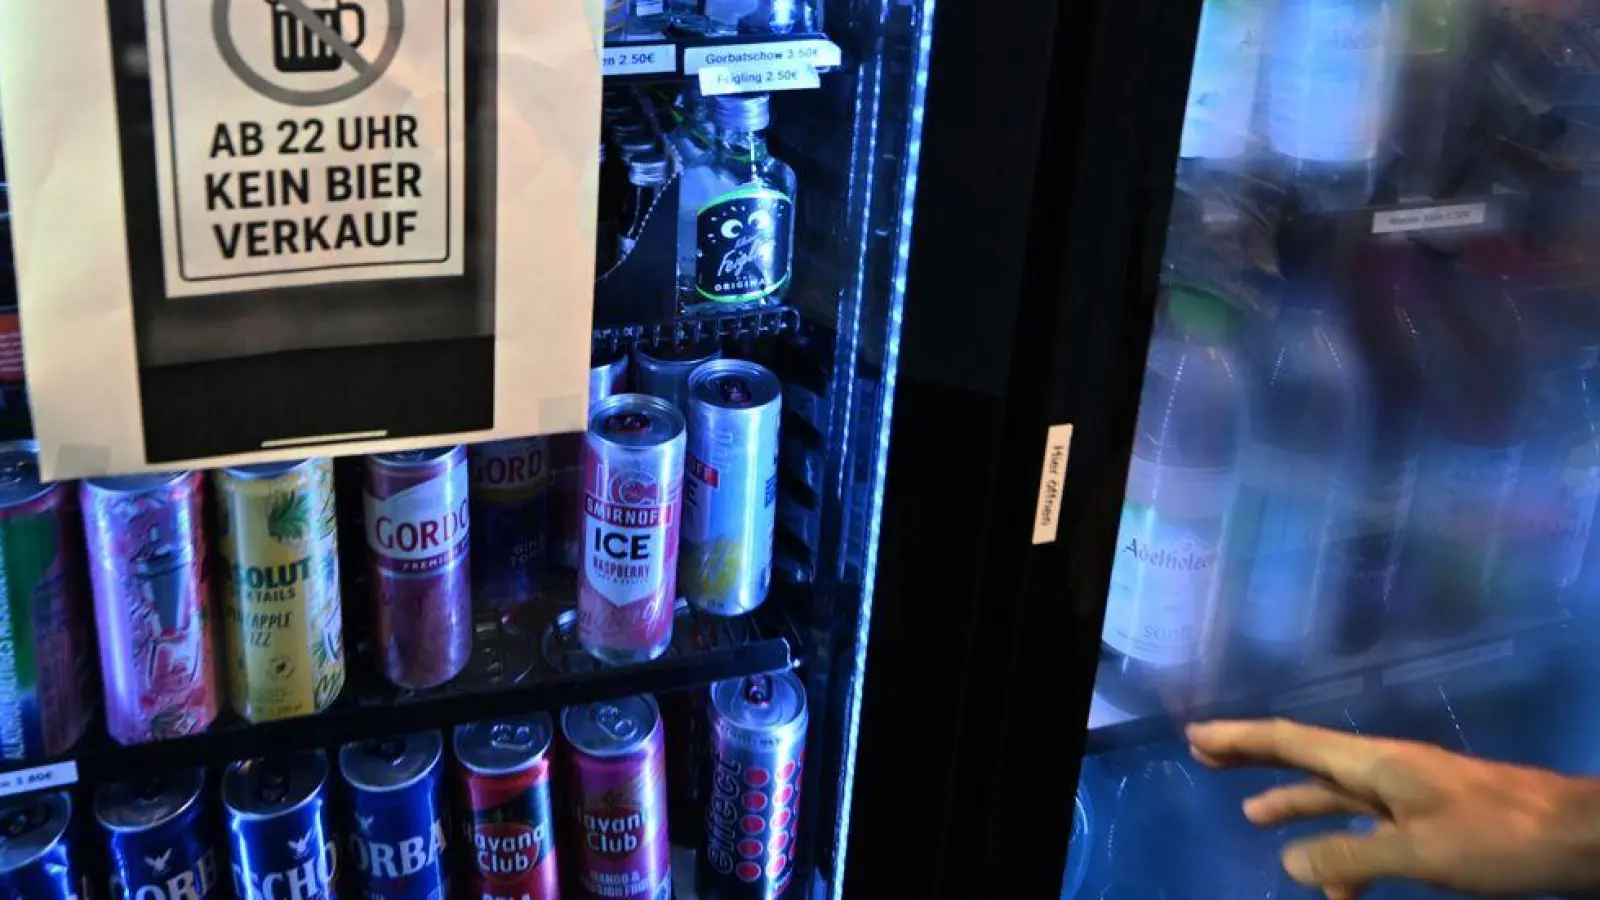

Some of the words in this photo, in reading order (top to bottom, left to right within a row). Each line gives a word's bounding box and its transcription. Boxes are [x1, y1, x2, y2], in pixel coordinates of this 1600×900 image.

[704, 50, 783, 65] Gorbatschow
[765, 69, 798, 82] 2.50€
[209, 121, 263, 158] AB
[276, 118, 325, 155] 22
[337, 114, 419, 151] UHR
[205, 167, 310, 210] KEIN
[327, 161, 422, 203] BIER
[213, 210, 419, 260] VERKAUF
[586, 496, 666, 526] SMIRNOF
[594, 527, 651, 560] ICE
[232, 556, 312, 589] SOLUT
[248, 630, 273, 648] IZZ
[587, 831, 639, 853] Club
[476, 850, 530, 873] Club
